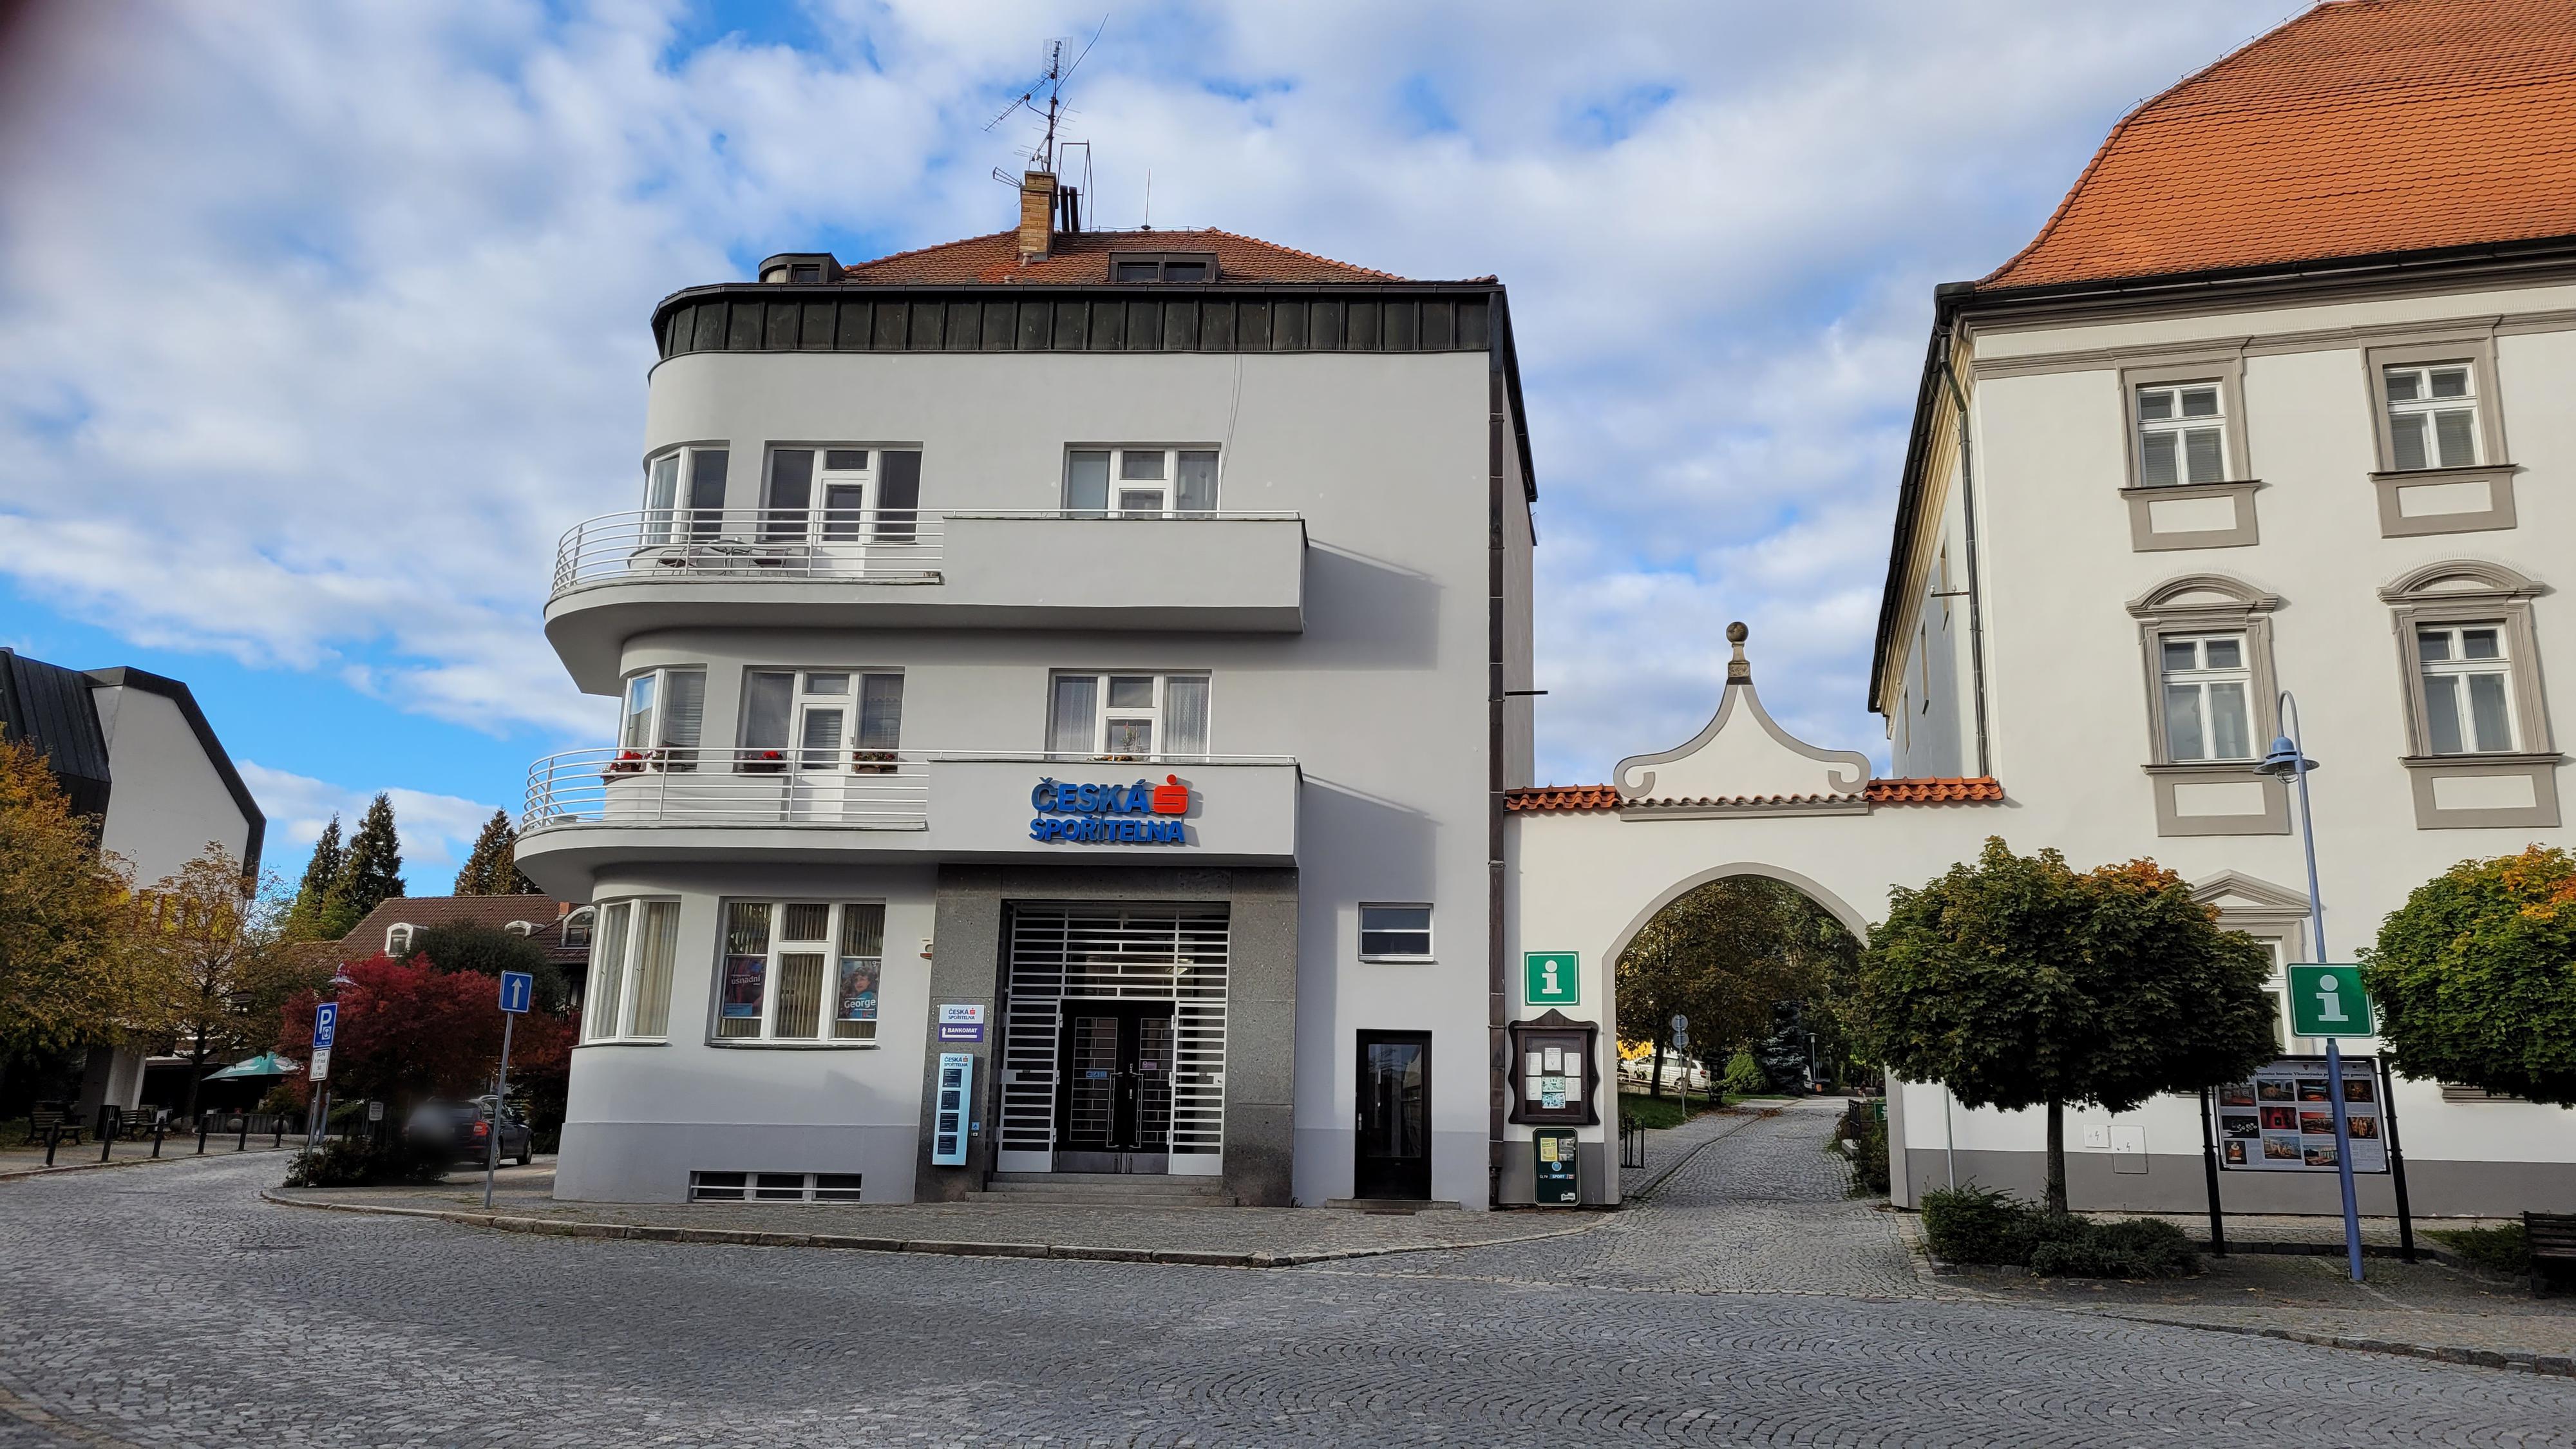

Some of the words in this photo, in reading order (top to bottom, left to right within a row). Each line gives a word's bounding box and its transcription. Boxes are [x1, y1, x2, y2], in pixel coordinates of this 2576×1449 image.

[1031, 777, 1150, 813] ČESKÁ
[1028, 814, 1186, 843] SPOŘITELNA
[844, 999, 876, 1009] George
